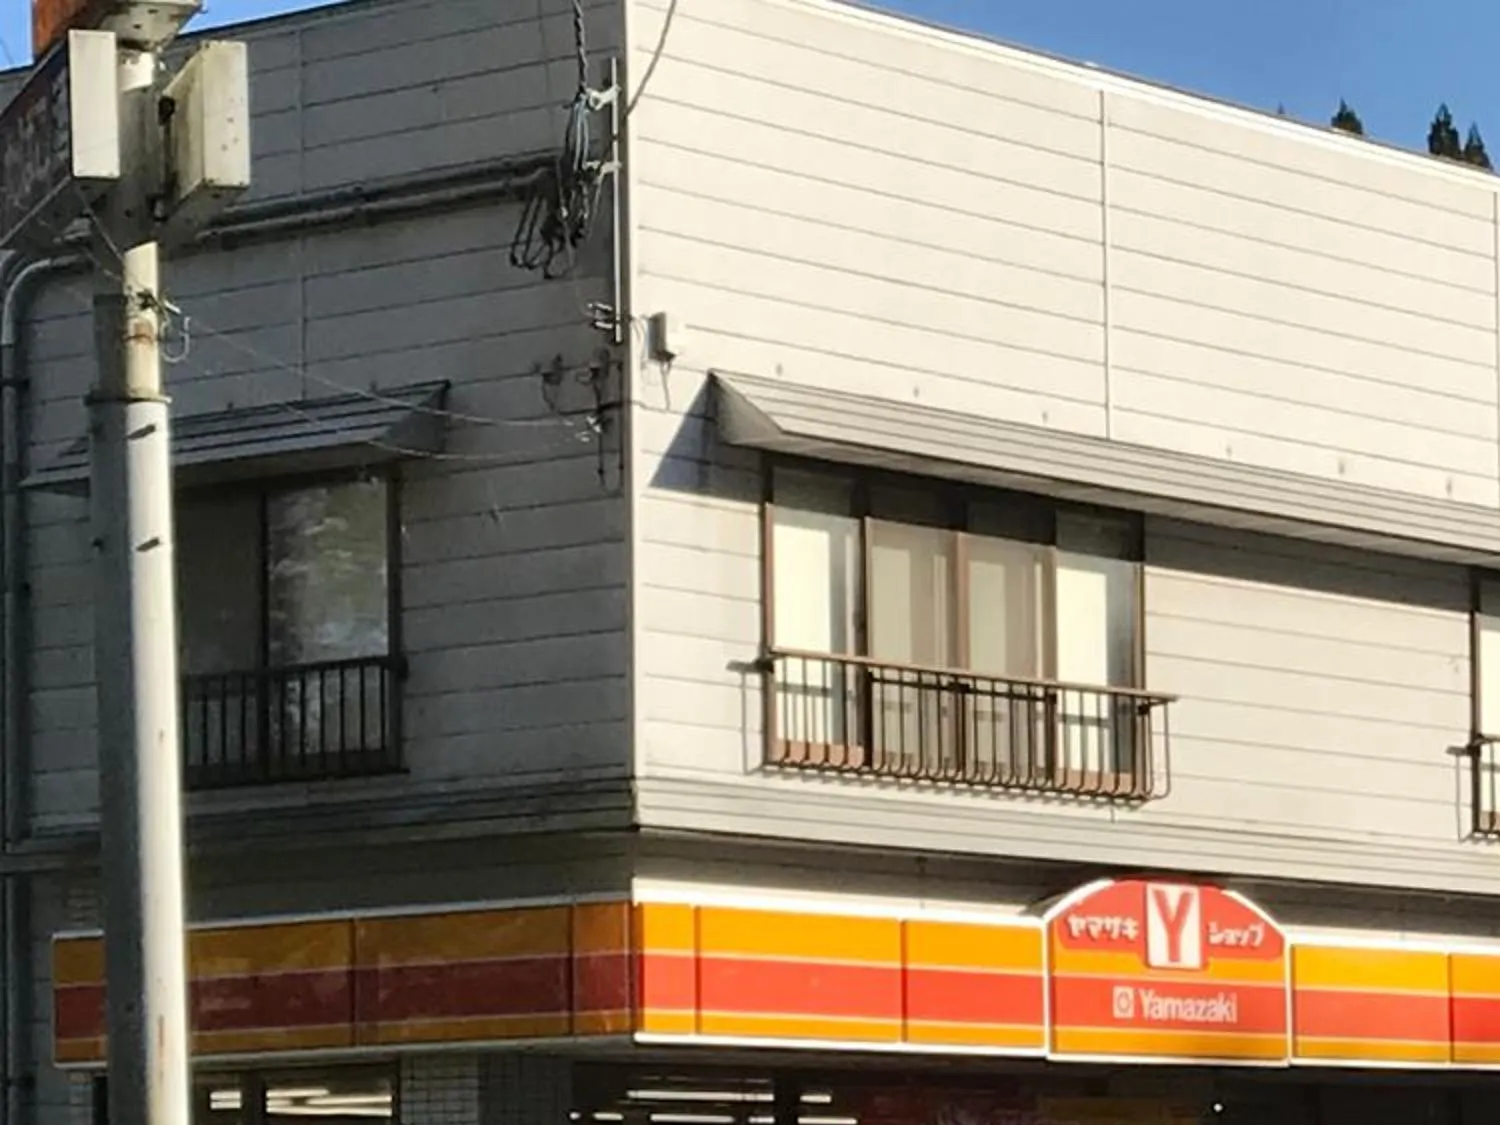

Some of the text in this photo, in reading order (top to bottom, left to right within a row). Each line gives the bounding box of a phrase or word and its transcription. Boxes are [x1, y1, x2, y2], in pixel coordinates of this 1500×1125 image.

[1068, 914, 1139, 941] ヤマザキ
[1152, 888, 1196, 963] Y
[1208, 920, 1266, 948] ショップ
[1138, 988, 1237, 1023] Yamazaki
